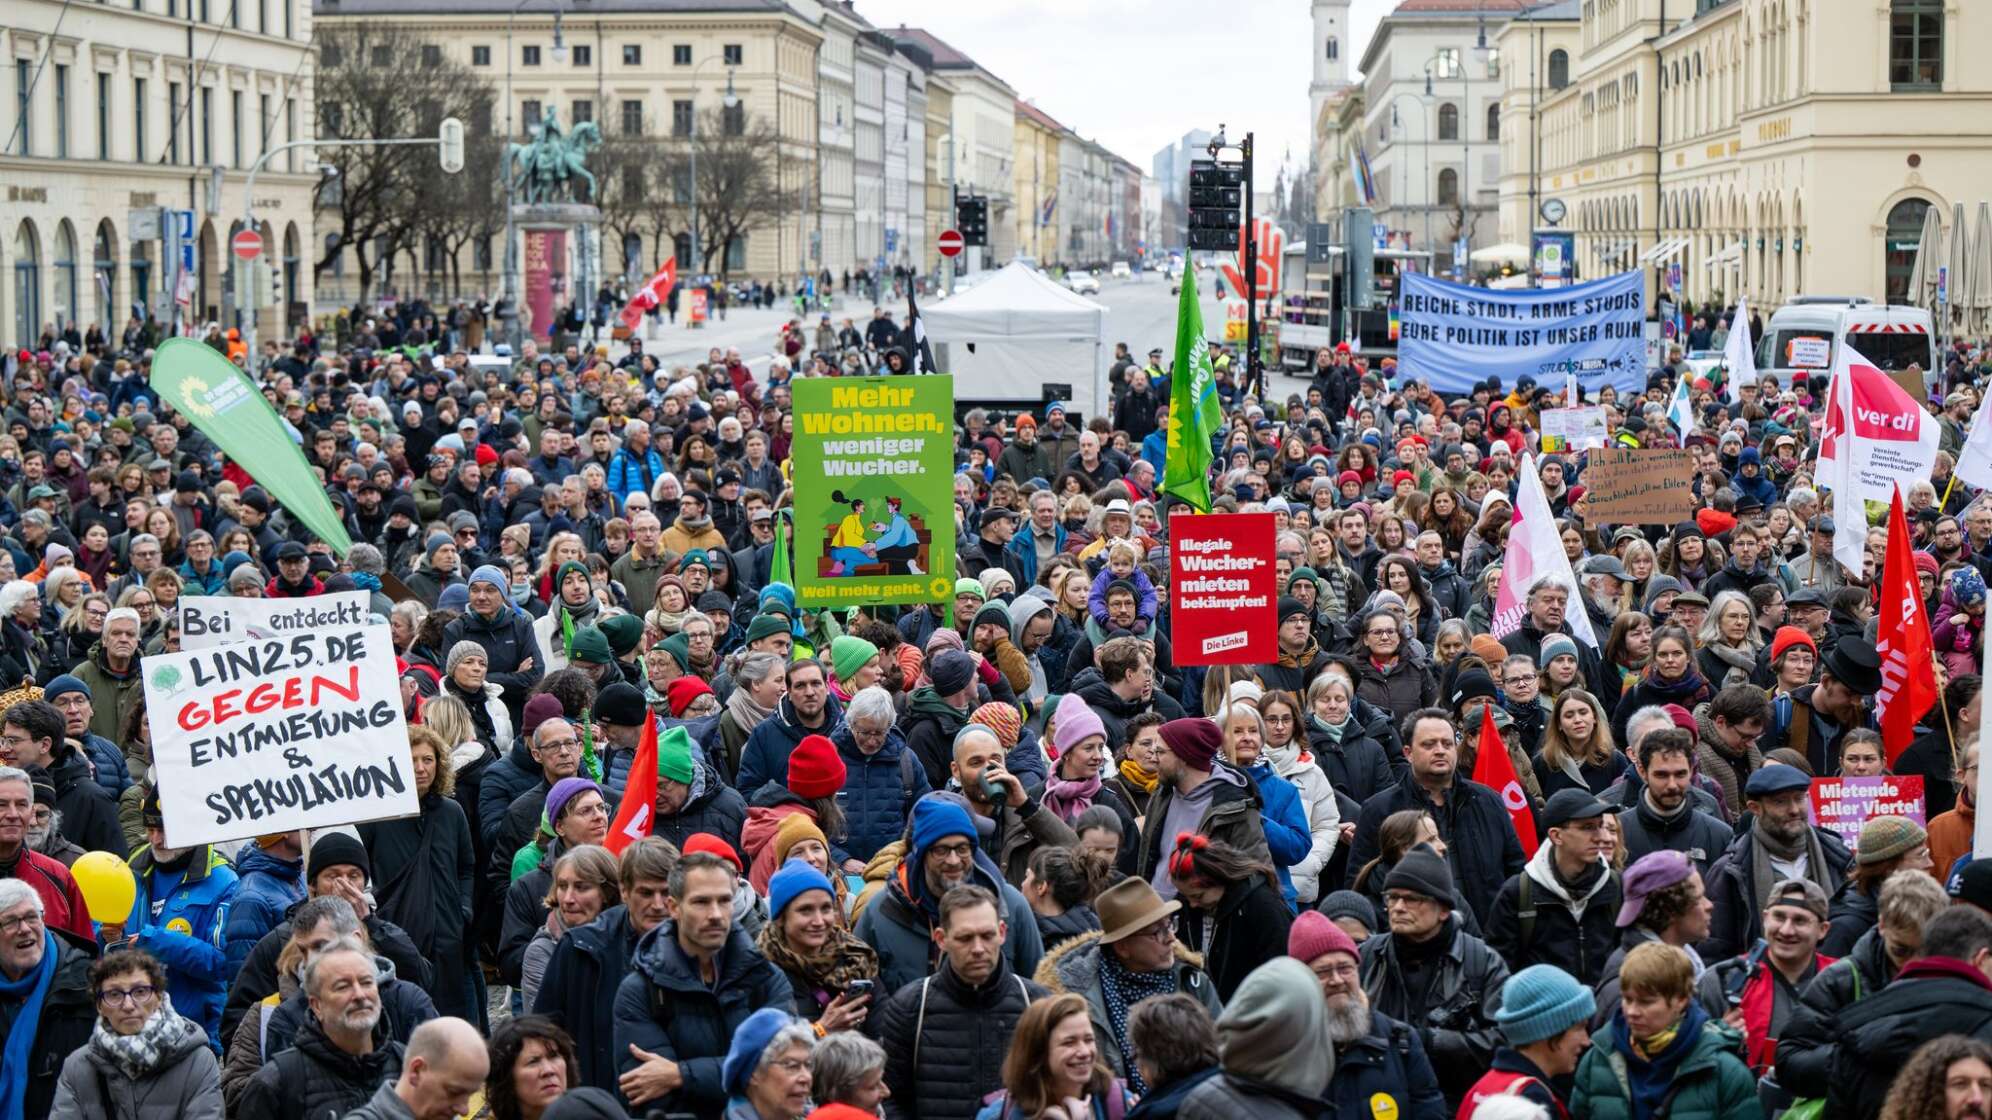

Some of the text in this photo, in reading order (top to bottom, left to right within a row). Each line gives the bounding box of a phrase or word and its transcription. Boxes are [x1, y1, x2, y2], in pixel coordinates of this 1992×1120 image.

[1404, 292, 1640, 320] REICHE STADT, ARME STUDIS
[1401, 320, 1641, 346] EURE POLITIK IST UNSER RUIN
[832, 385, 914, 408] Mehr
[802, 411, 944, 434] Wohnen,
[1857, 406, 1915, 432] ver.di
[823, 437, 925, 456] weniger
[823, 459, 926, 477] Wucher.
[1589, 449, 1606, 467] Ich
[1180, 539, 1233, 553] Illegale
[1180, 554, 1266, 571] Wucher-
[802, 583, 925, 598] Weil mehr geht.
[1180, 576, 1249, 593] mieten
[1180, 595, 1267, 611] bekämpfen!
[183, 607, 231, 636] Bei
[1206, 636, 1245, 650] Die Linke
[189, 632, 367, 687] LIN25.DE
[177, 665, 360, 732] GEGEN
[190, 700, 396, 768] ENTMIETUNG
[282, 747, 313, 769] &
[205, 756, 406, 825] SPEKULATION
[1819, 783, 1899, 799] Mietende
[1820, 799, 1920, 816] aller Viertel
